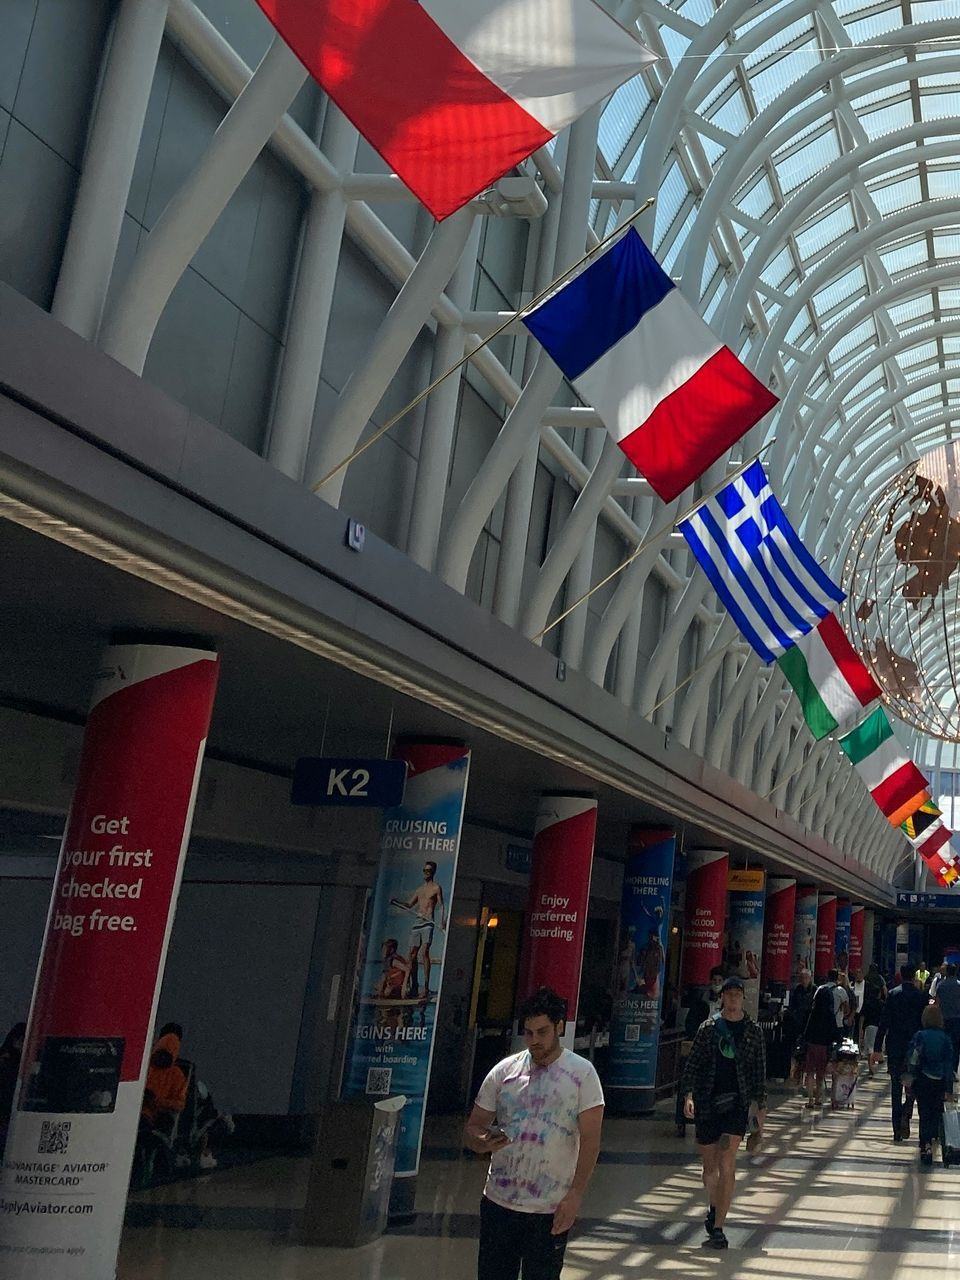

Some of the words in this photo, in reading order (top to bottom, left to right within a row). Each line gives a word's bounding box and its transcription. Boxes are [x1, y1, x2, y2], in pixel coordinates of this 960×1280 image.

[327, 768, 370, 797] K2
[90, 814, 130, 835] Get
[385, 820, 448, 835] CRUISING
[417, 836, 456, 852] THERE
[62, 850, 106, 872] your
[108, 845, 154, 867] first
[61, 877, 144, 900] checked
[632, 886, 659, 896] THERE
[541, 894, 570, 909] Enjoy
[53, 909, 86, 937] bag
[89, 909, 138, 932] free.
[531, 909, 578, 927] preferred
[395, 1025, 428, 1041] HERE
[375, 1045, 394, 1053] with
[382, 1054, 418, 1066] boarding
